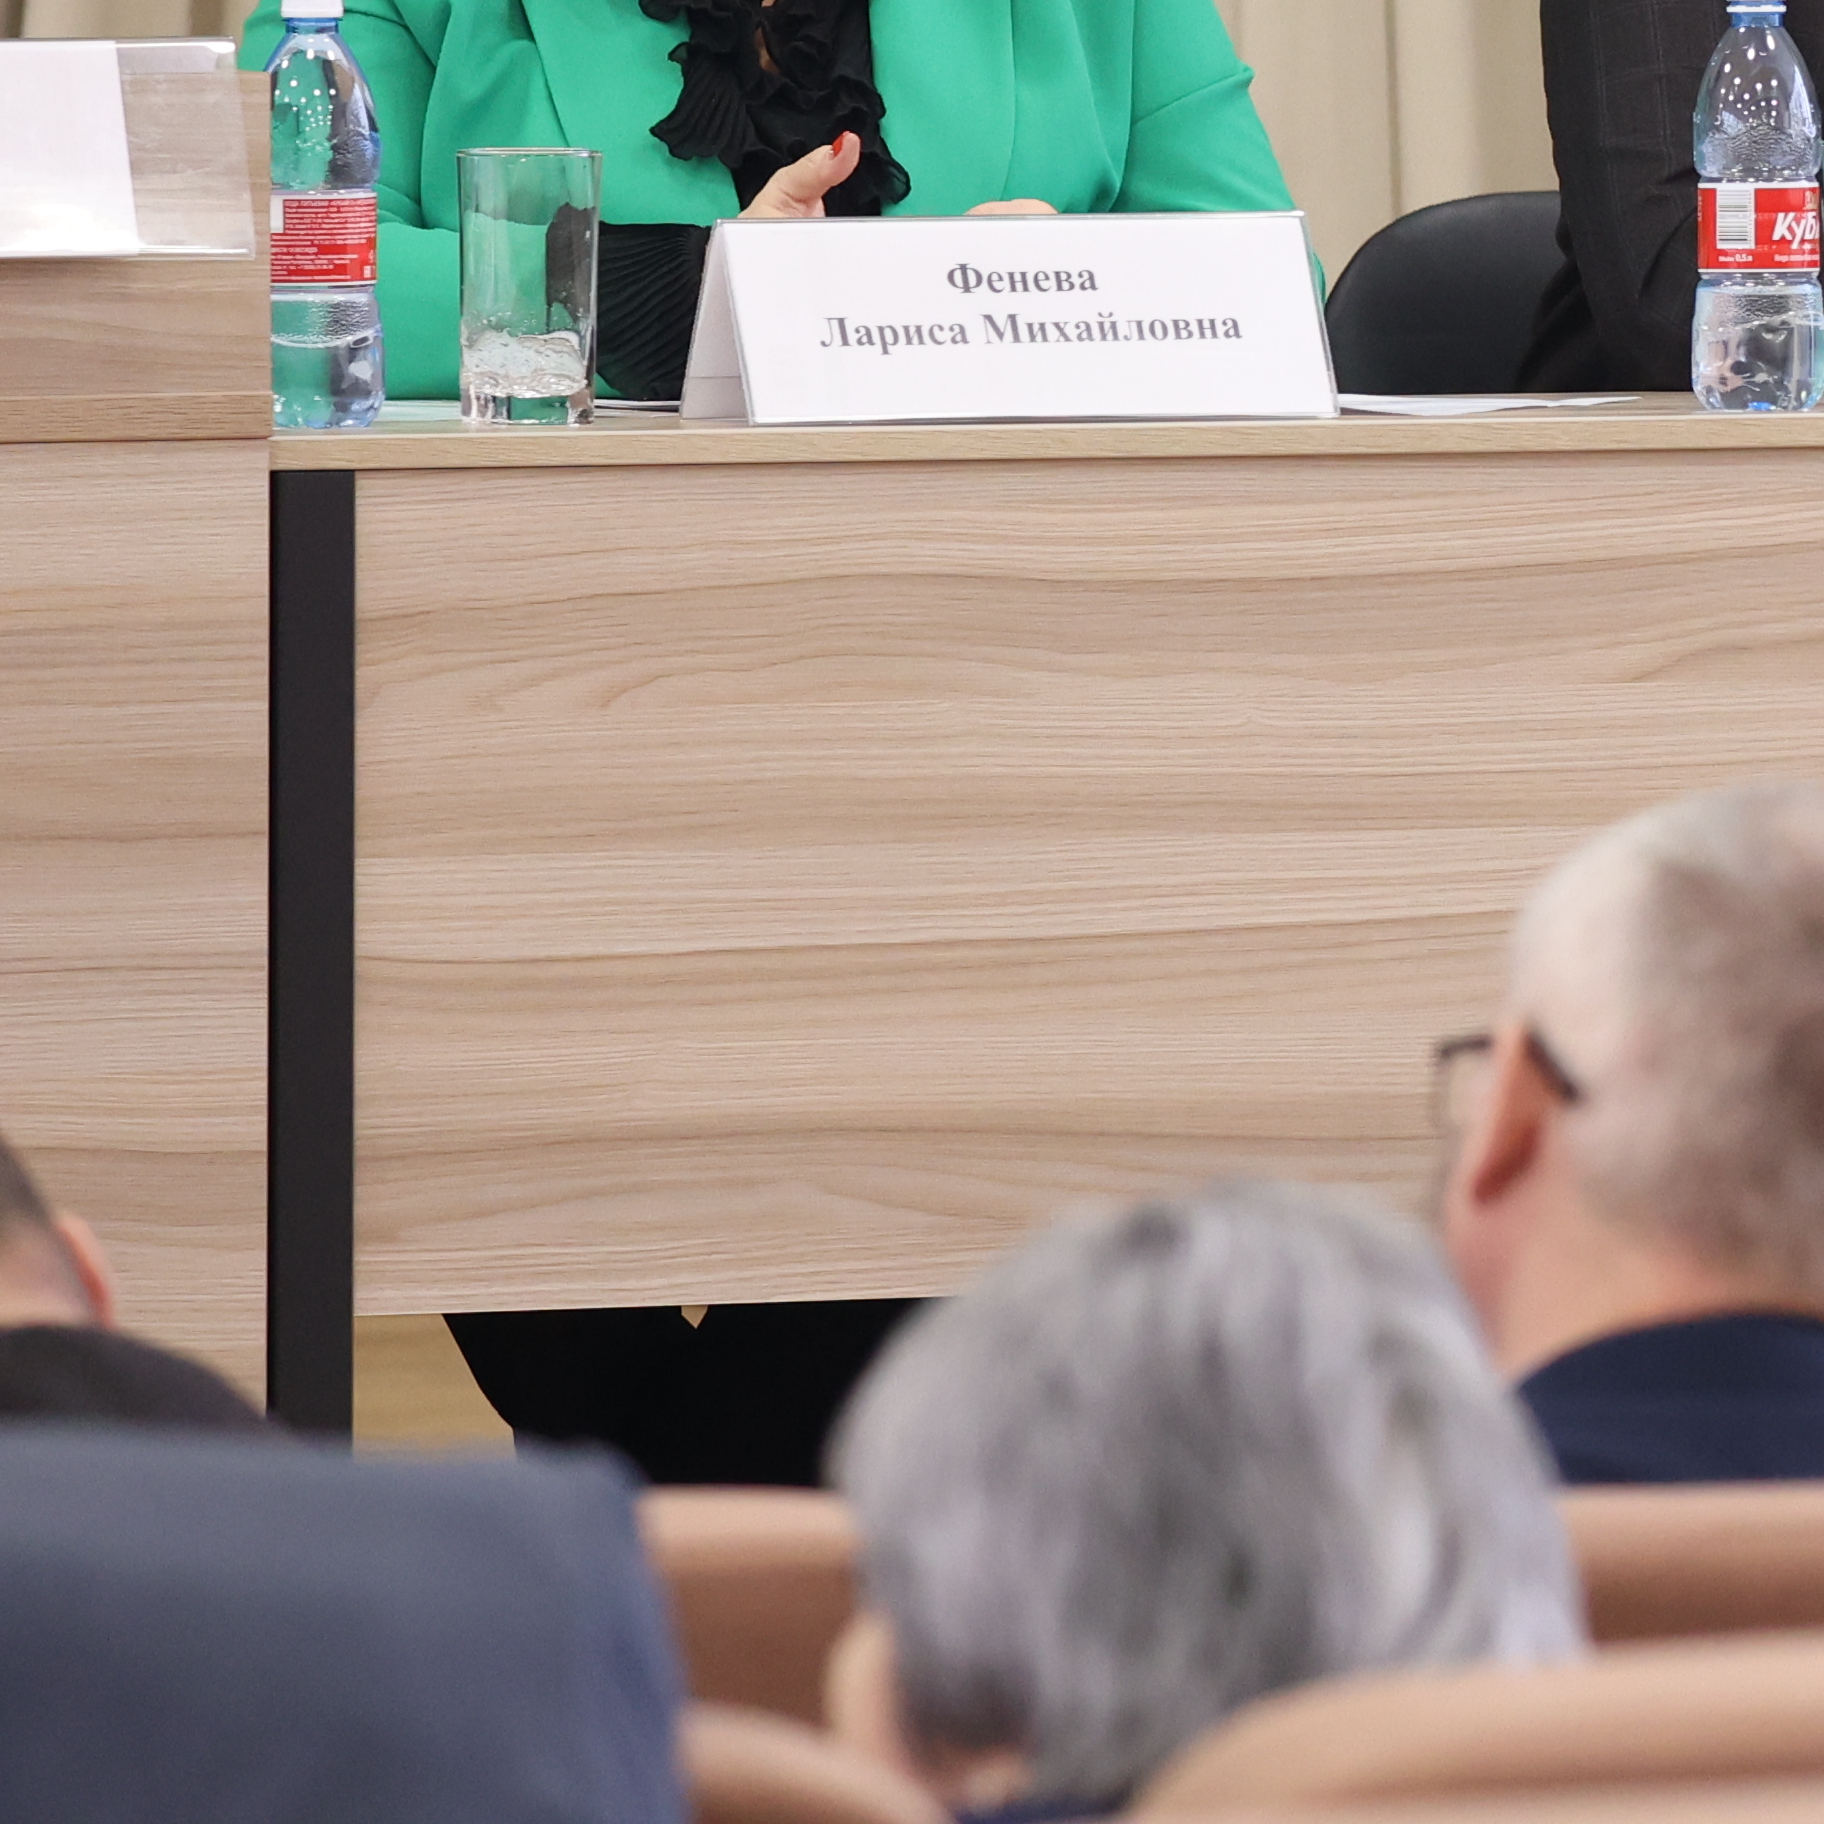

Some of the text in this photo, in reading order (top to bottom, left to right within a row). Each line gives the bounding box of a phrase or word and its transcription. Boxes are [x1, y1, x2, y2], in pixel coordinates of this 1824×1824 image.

[945, 262, 1100, 295] Фенева
[819, 311, 1244, 357] Лариса Михайловна
